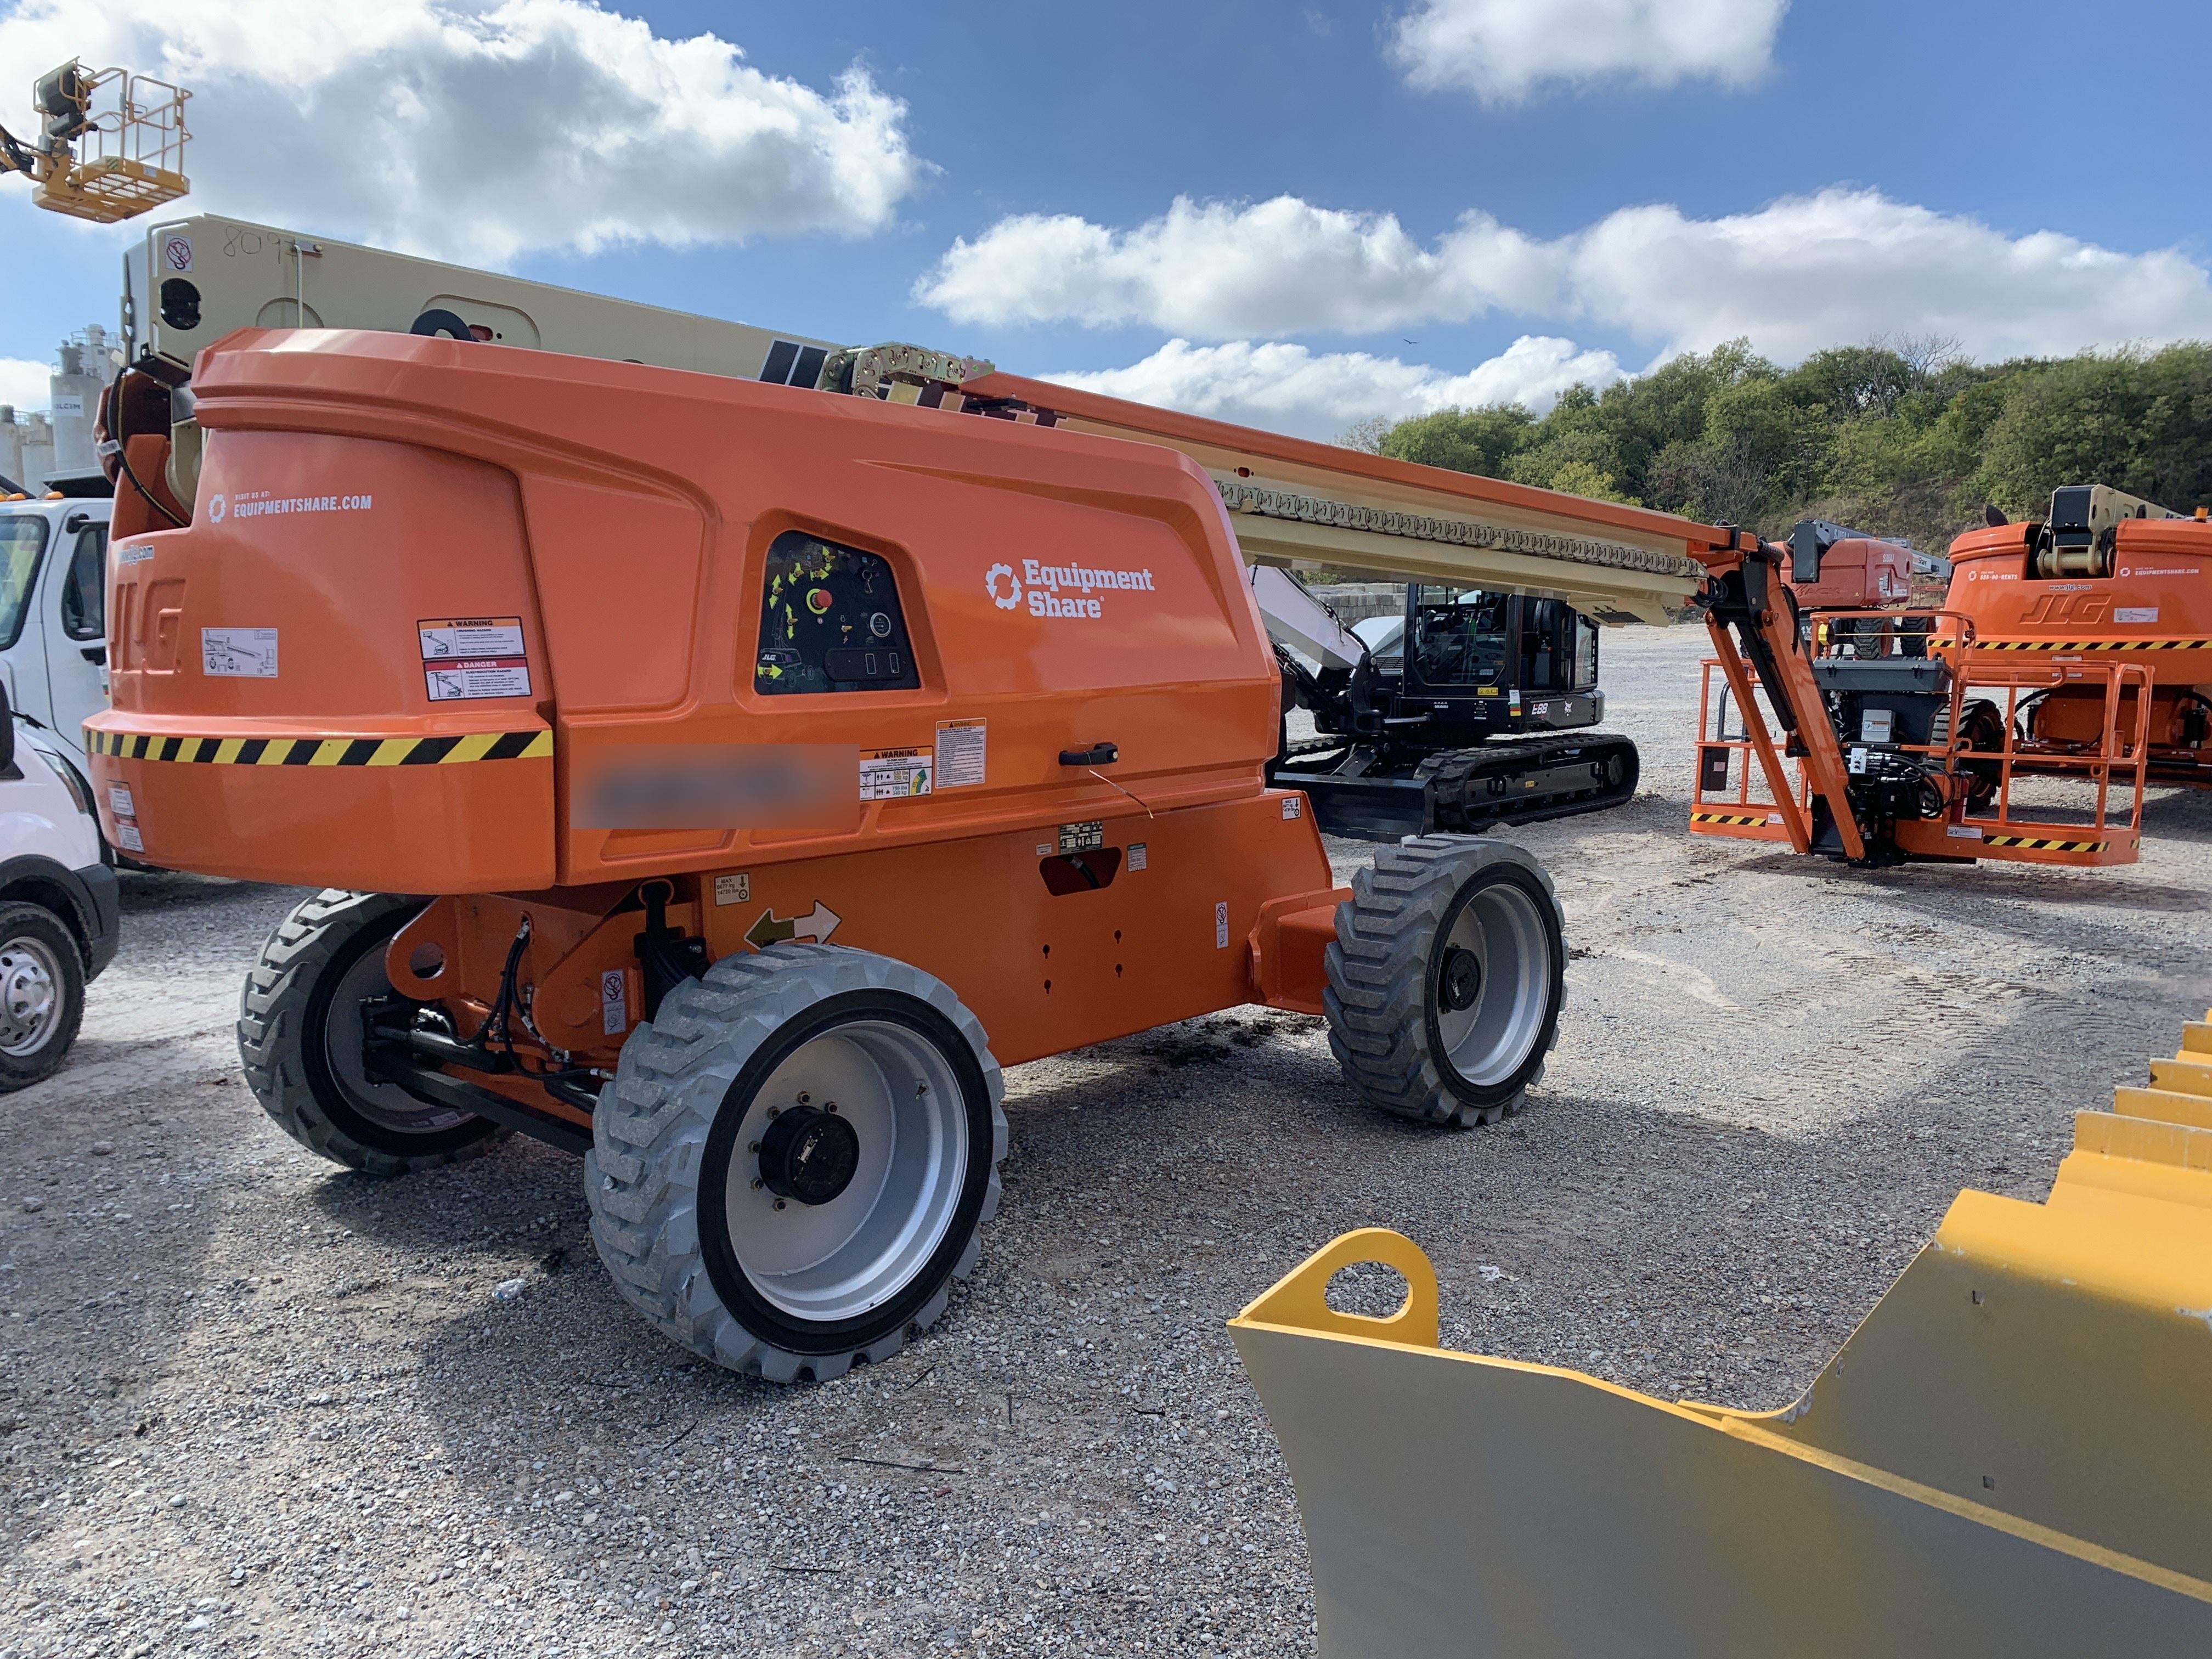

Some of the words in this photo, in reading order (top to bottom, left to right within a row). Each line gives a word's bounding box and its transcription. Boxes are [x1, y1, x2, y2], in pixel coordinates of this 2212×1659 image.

[234, 495, 372, 518] EQUIPMENTSHARE.COM
[1022, 558, 1155, 593] Equipment
[1028, 591, 1102, 618] Share
[2019, 594, 2112, 624] JLG
[882, 749, 918, 758] WARNING
